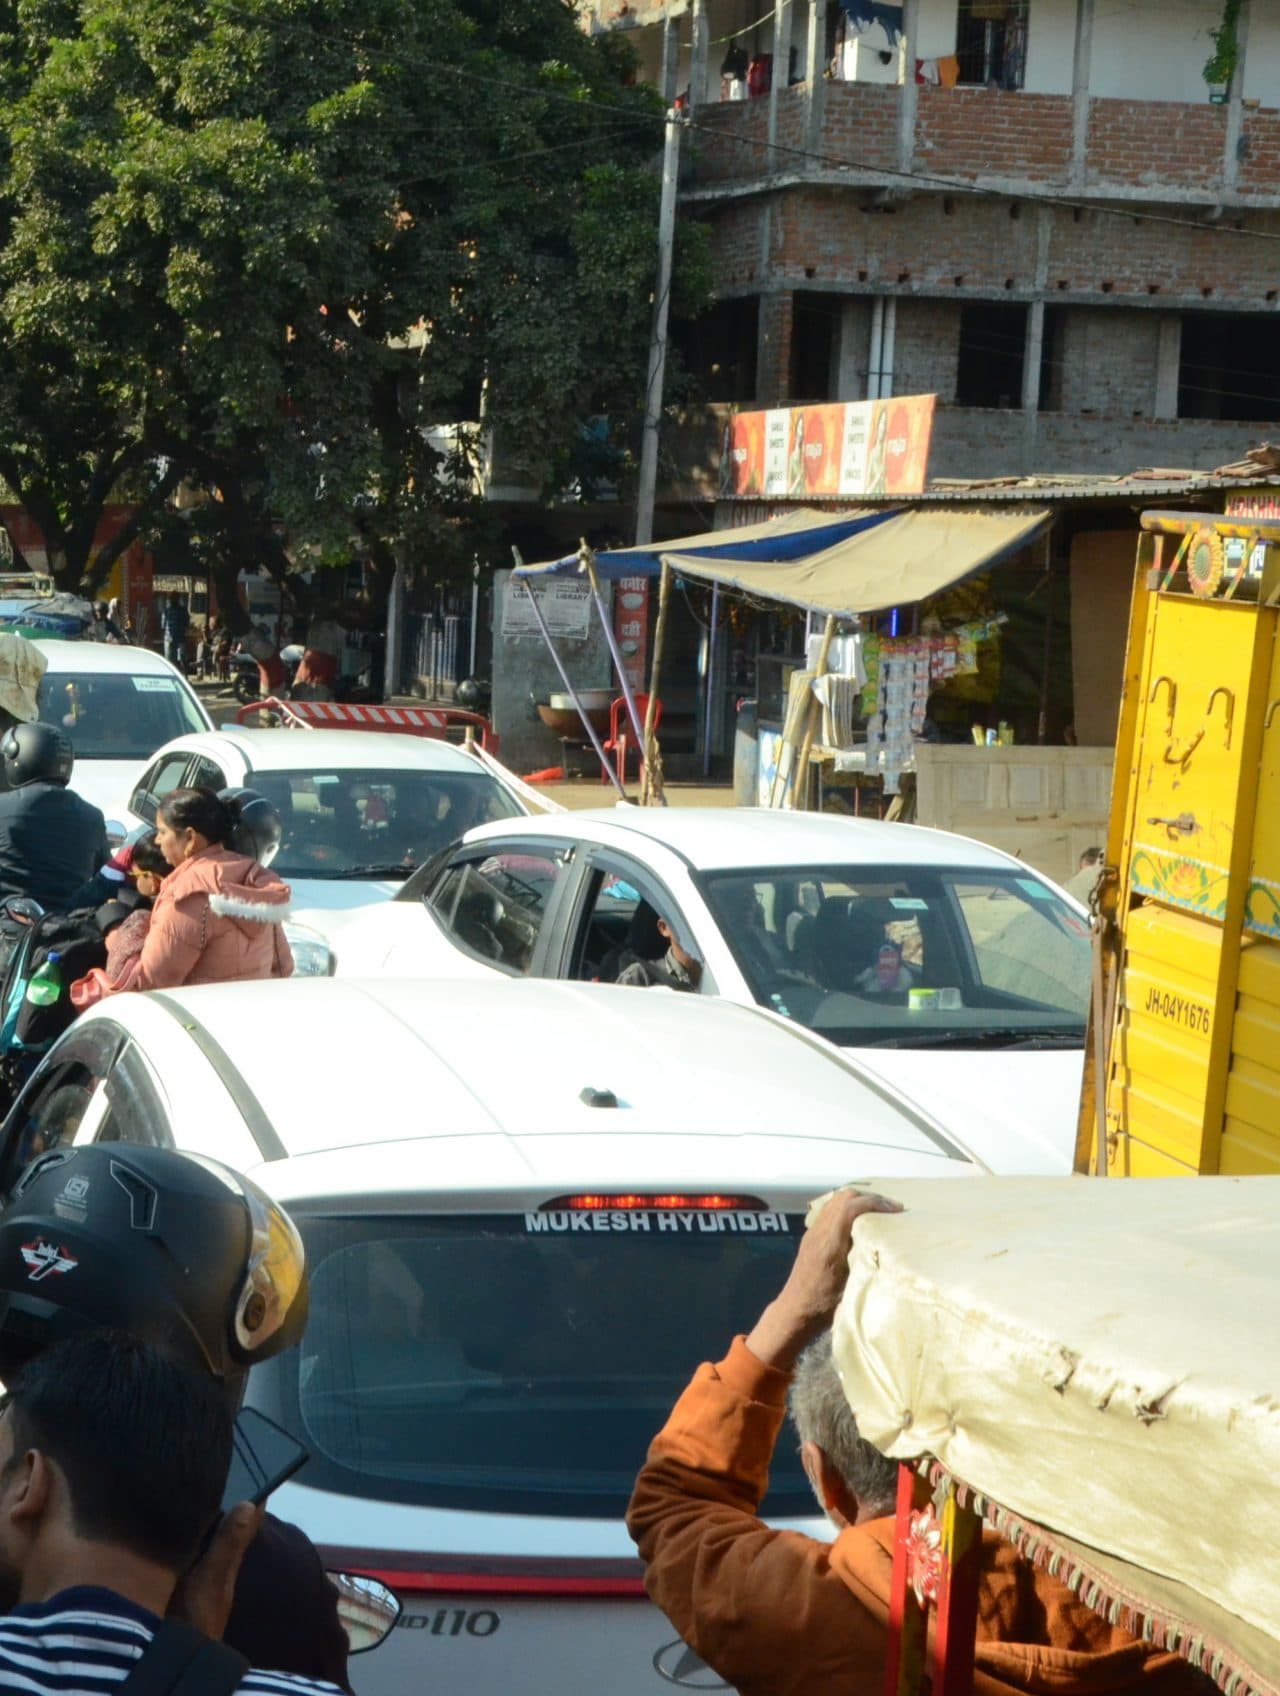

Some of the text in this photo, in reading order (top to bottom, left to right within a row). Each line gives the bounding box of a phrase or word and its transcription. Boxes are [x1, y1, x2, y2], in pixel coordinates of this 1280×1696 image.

[513, 591, 545, 599] LIBRRY
[1145, 987, 1210, 1034] JH-04Y1676
[525, 1212, 790, 1233] MUKESH HYUNDAI
